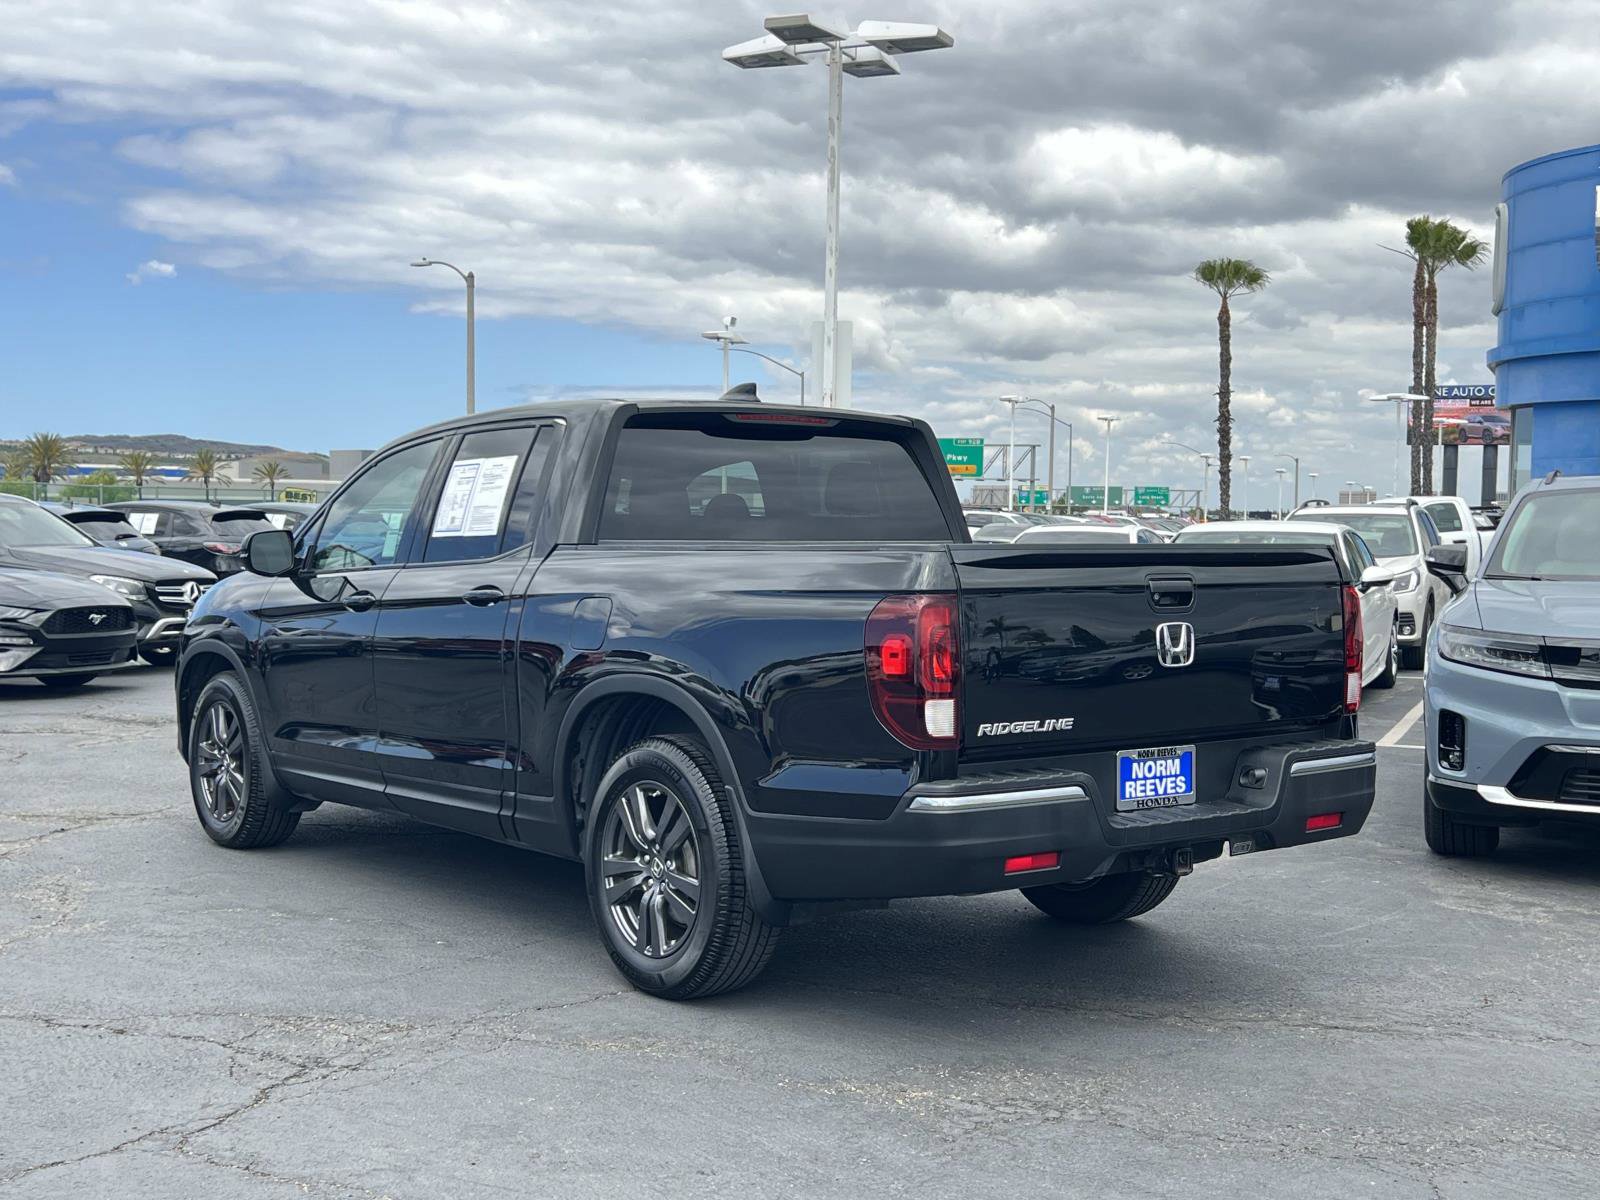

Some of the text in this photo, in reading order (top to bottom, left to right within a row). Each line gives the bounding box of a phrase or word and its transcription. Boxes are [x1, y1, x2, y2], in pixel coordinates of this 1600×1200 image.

[1451, 386, 1485, 397] AUTO
[946, 453, 968, 463] Pkwy
[285, 491, 314, 501] BEST
[977, 717, 1075, 737] RIDGELINE
[1137, 747, 1177, 758] NORM REEVES
[1132, 758, 1181, 779] NORM
[1125, 775, 1186, 798] REEVES
[1136, 797, 1179, 808] HONDA
